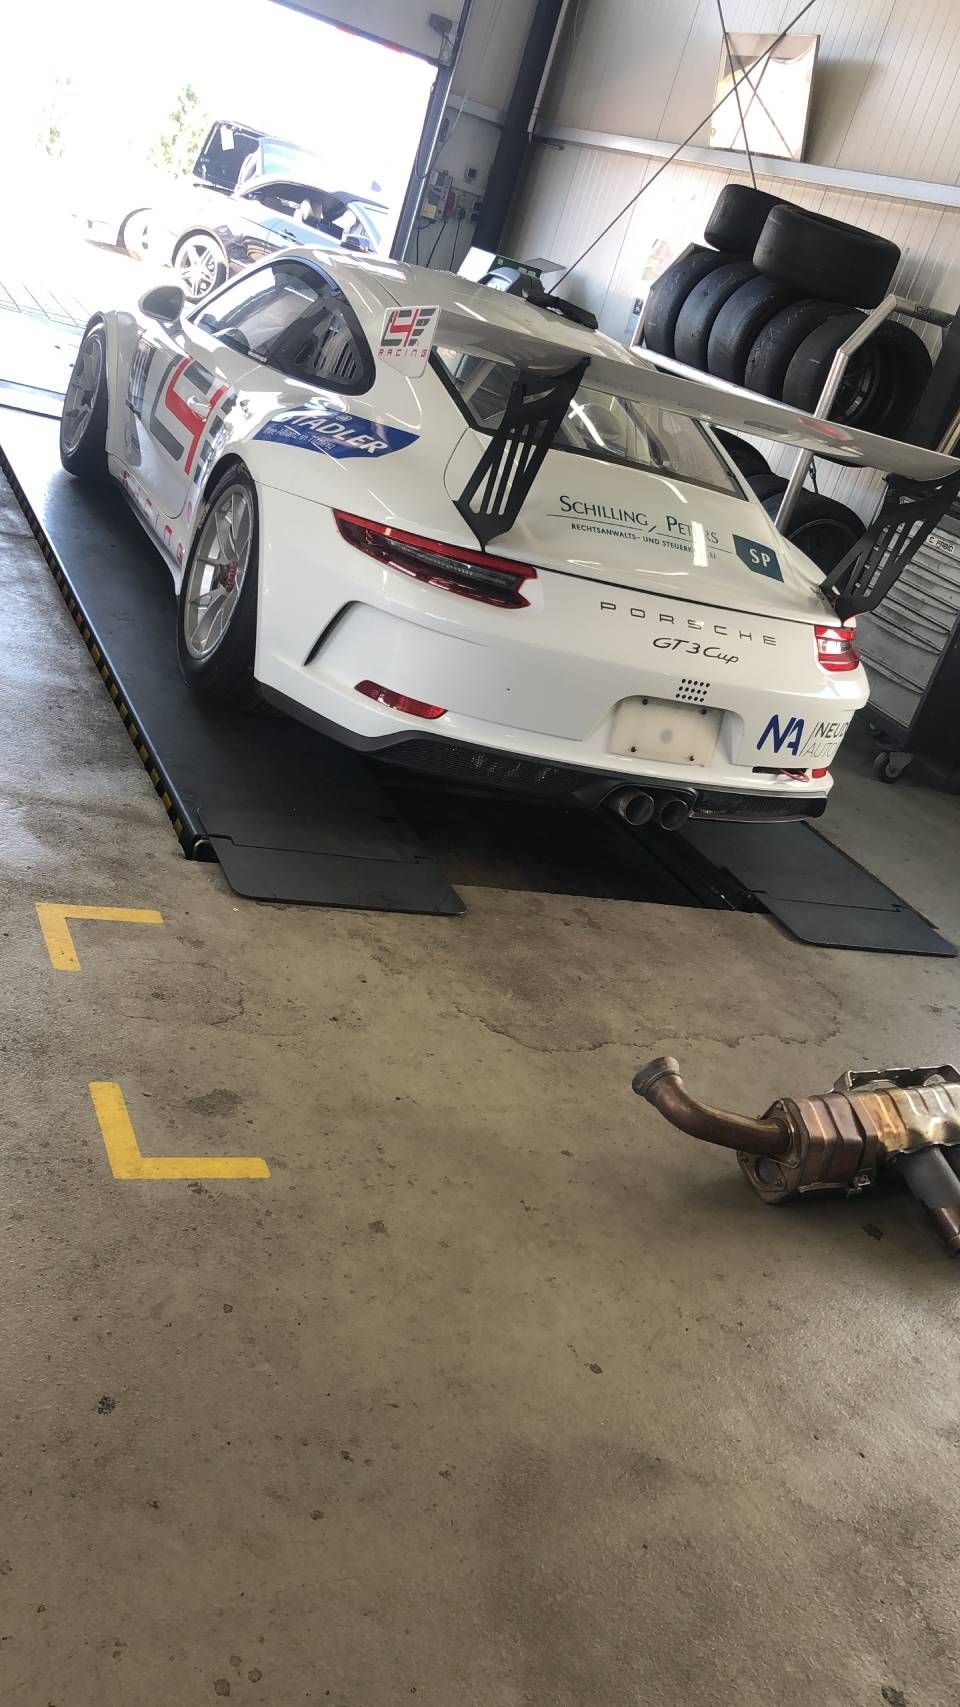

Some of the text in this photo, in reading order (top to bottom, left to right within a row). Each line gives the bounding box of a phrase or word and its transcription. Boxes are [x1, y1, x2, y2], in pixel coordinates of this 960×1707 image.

[378, 348, 428, 357] RACING
[559, 495, 719, 544] SCHILLING PETRS
[749, 548, 771, 567] SP
[600, 601, 777, 646] PORSCHE
[756, 714, 805, 756] NA
